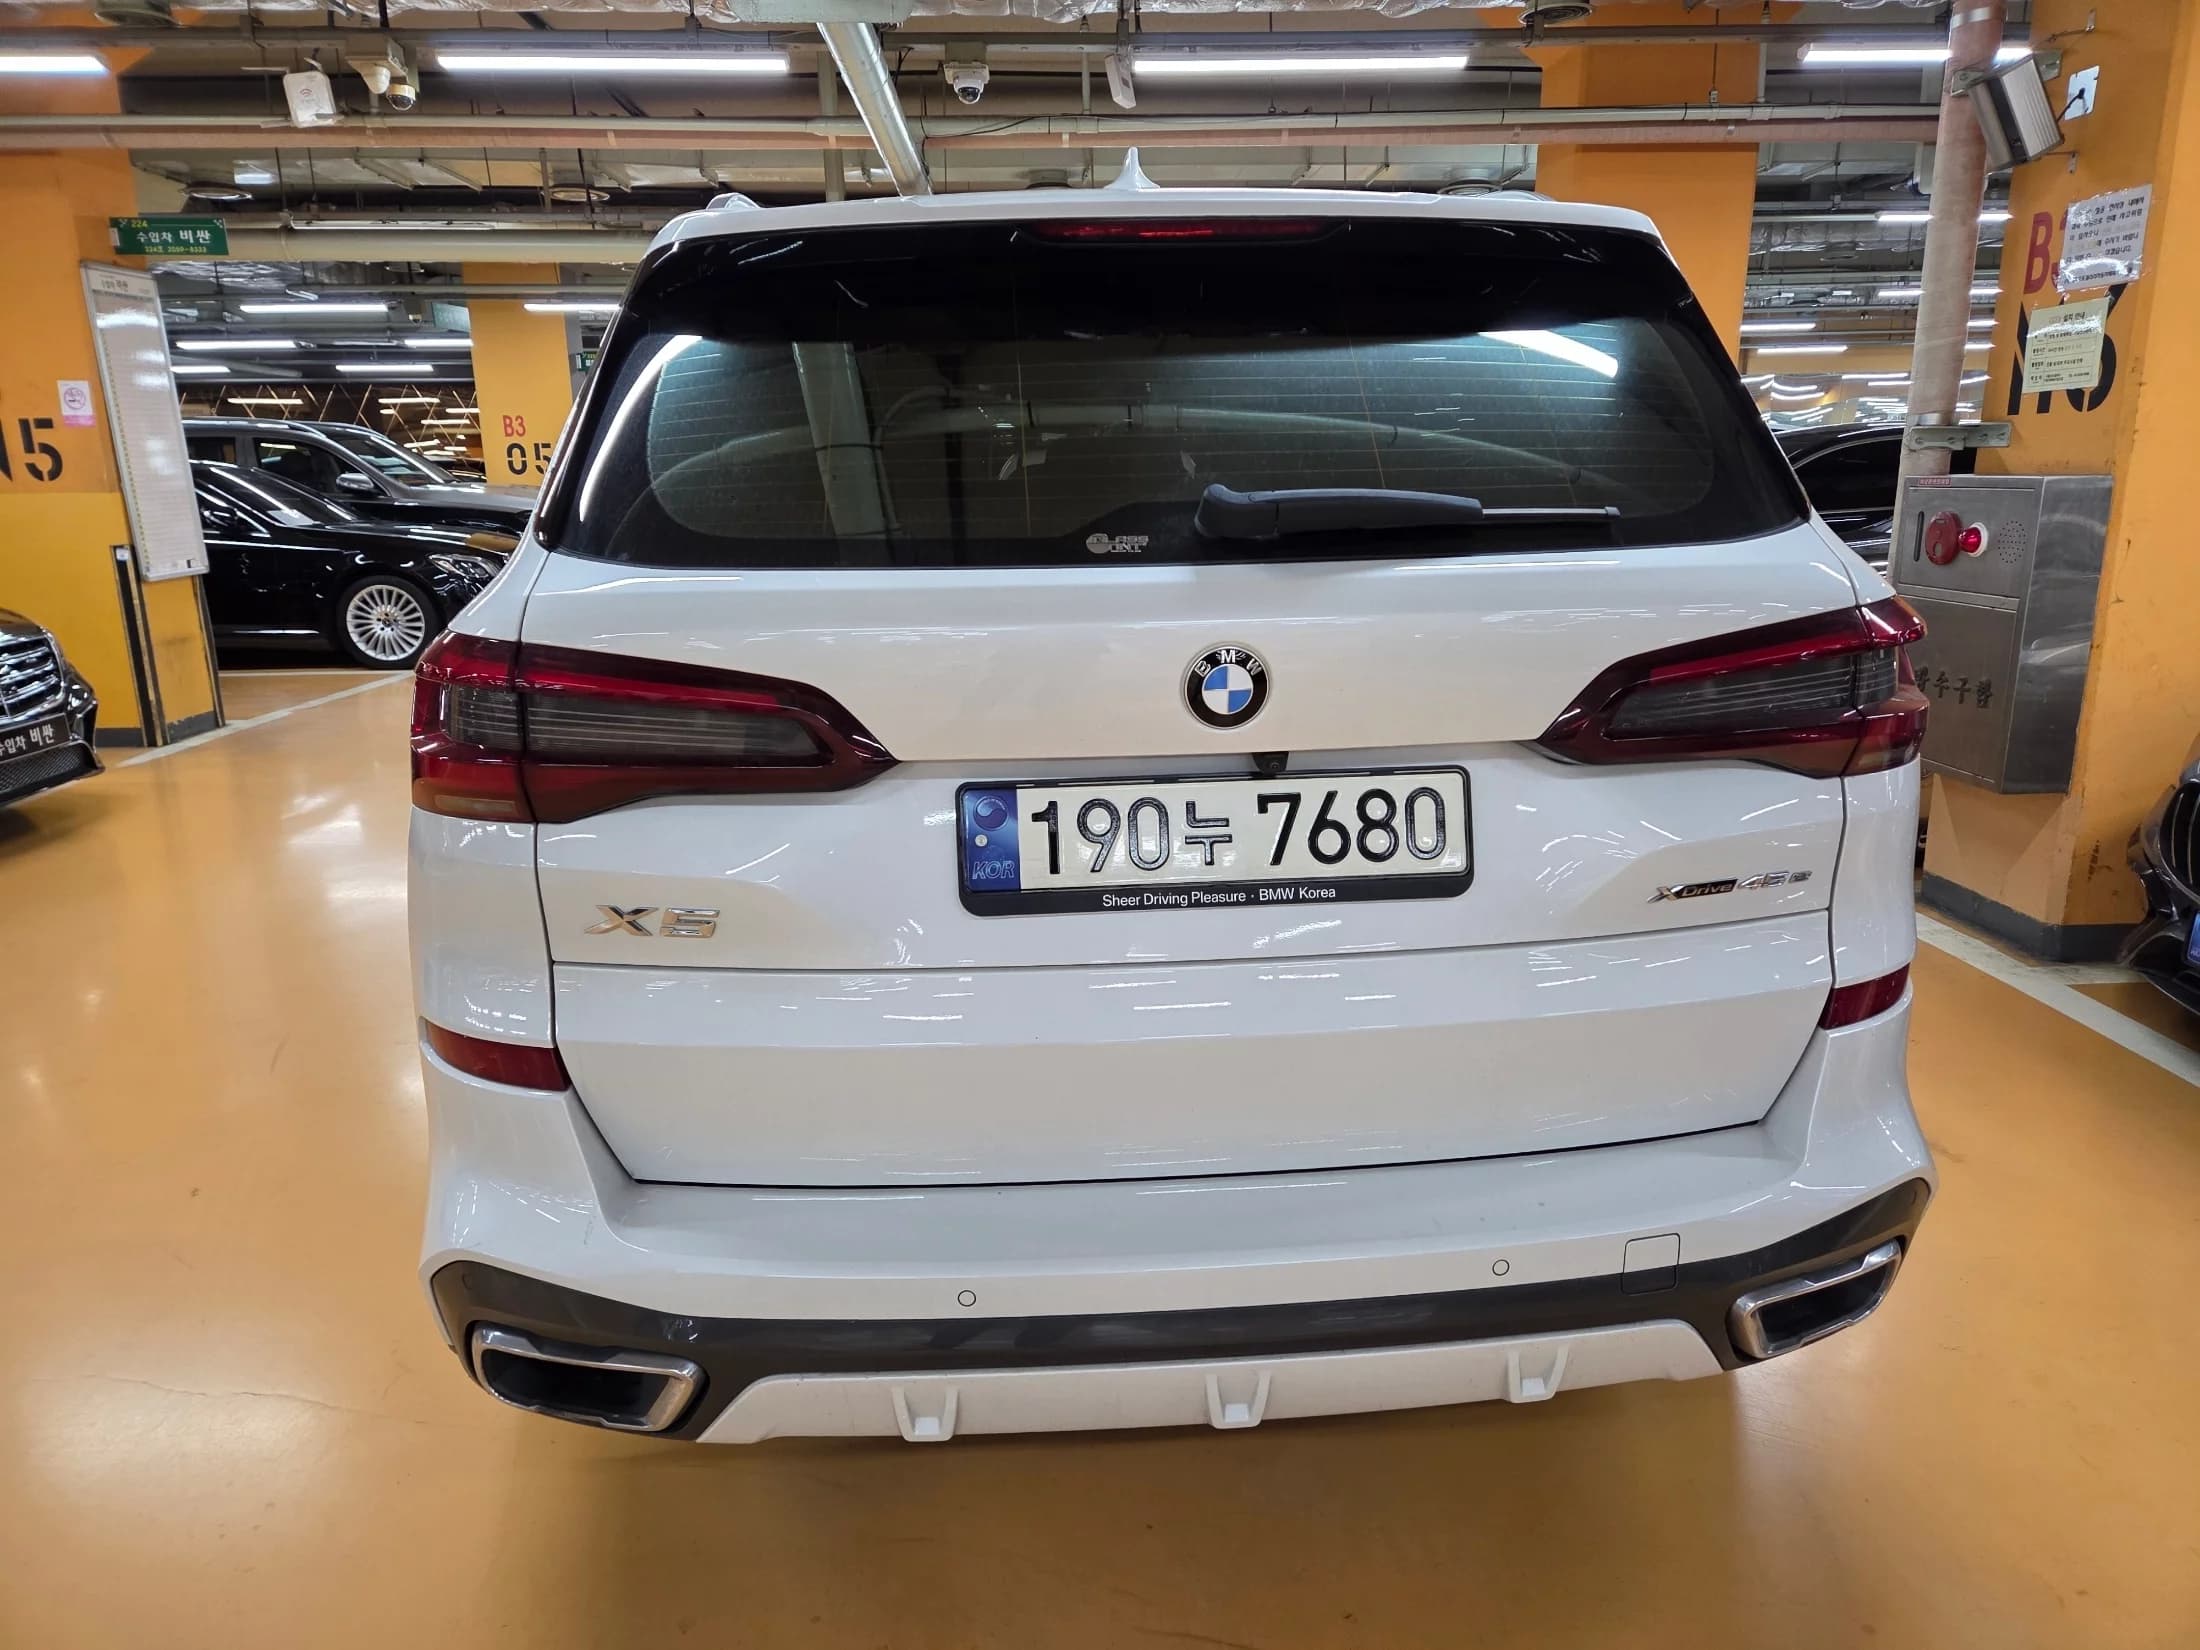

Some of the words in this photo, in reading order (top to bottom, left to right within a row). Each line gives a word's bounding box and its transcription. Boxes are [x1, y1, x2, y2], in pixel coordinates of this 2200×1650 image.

[136, 231, 173, 244] 수입차
[179, 229, 211, 244] 비싼
[502, 415, 526, 438] B3
[0, 417, 63, 482] 5
[506, 442, 552, 476] 05
[1194, 649, 1262, 677] BMW
[29, 723, 55, 746] 비싼
[1031, 796, 1233, 875] 190누
[1256, 786, 1447, 866] 7680
[972, 859, 1016, 881] KOR
[1102, 893, 1141, 908] Sheer
[1143, 891, 1189, 907] Driving
[1191, 890, 1247, 905] Pleasure
[1258, 887, 1295, 902] BMW
[1298, 886, 1336, 899] Korea
[584, 904, 721, 939] X5
